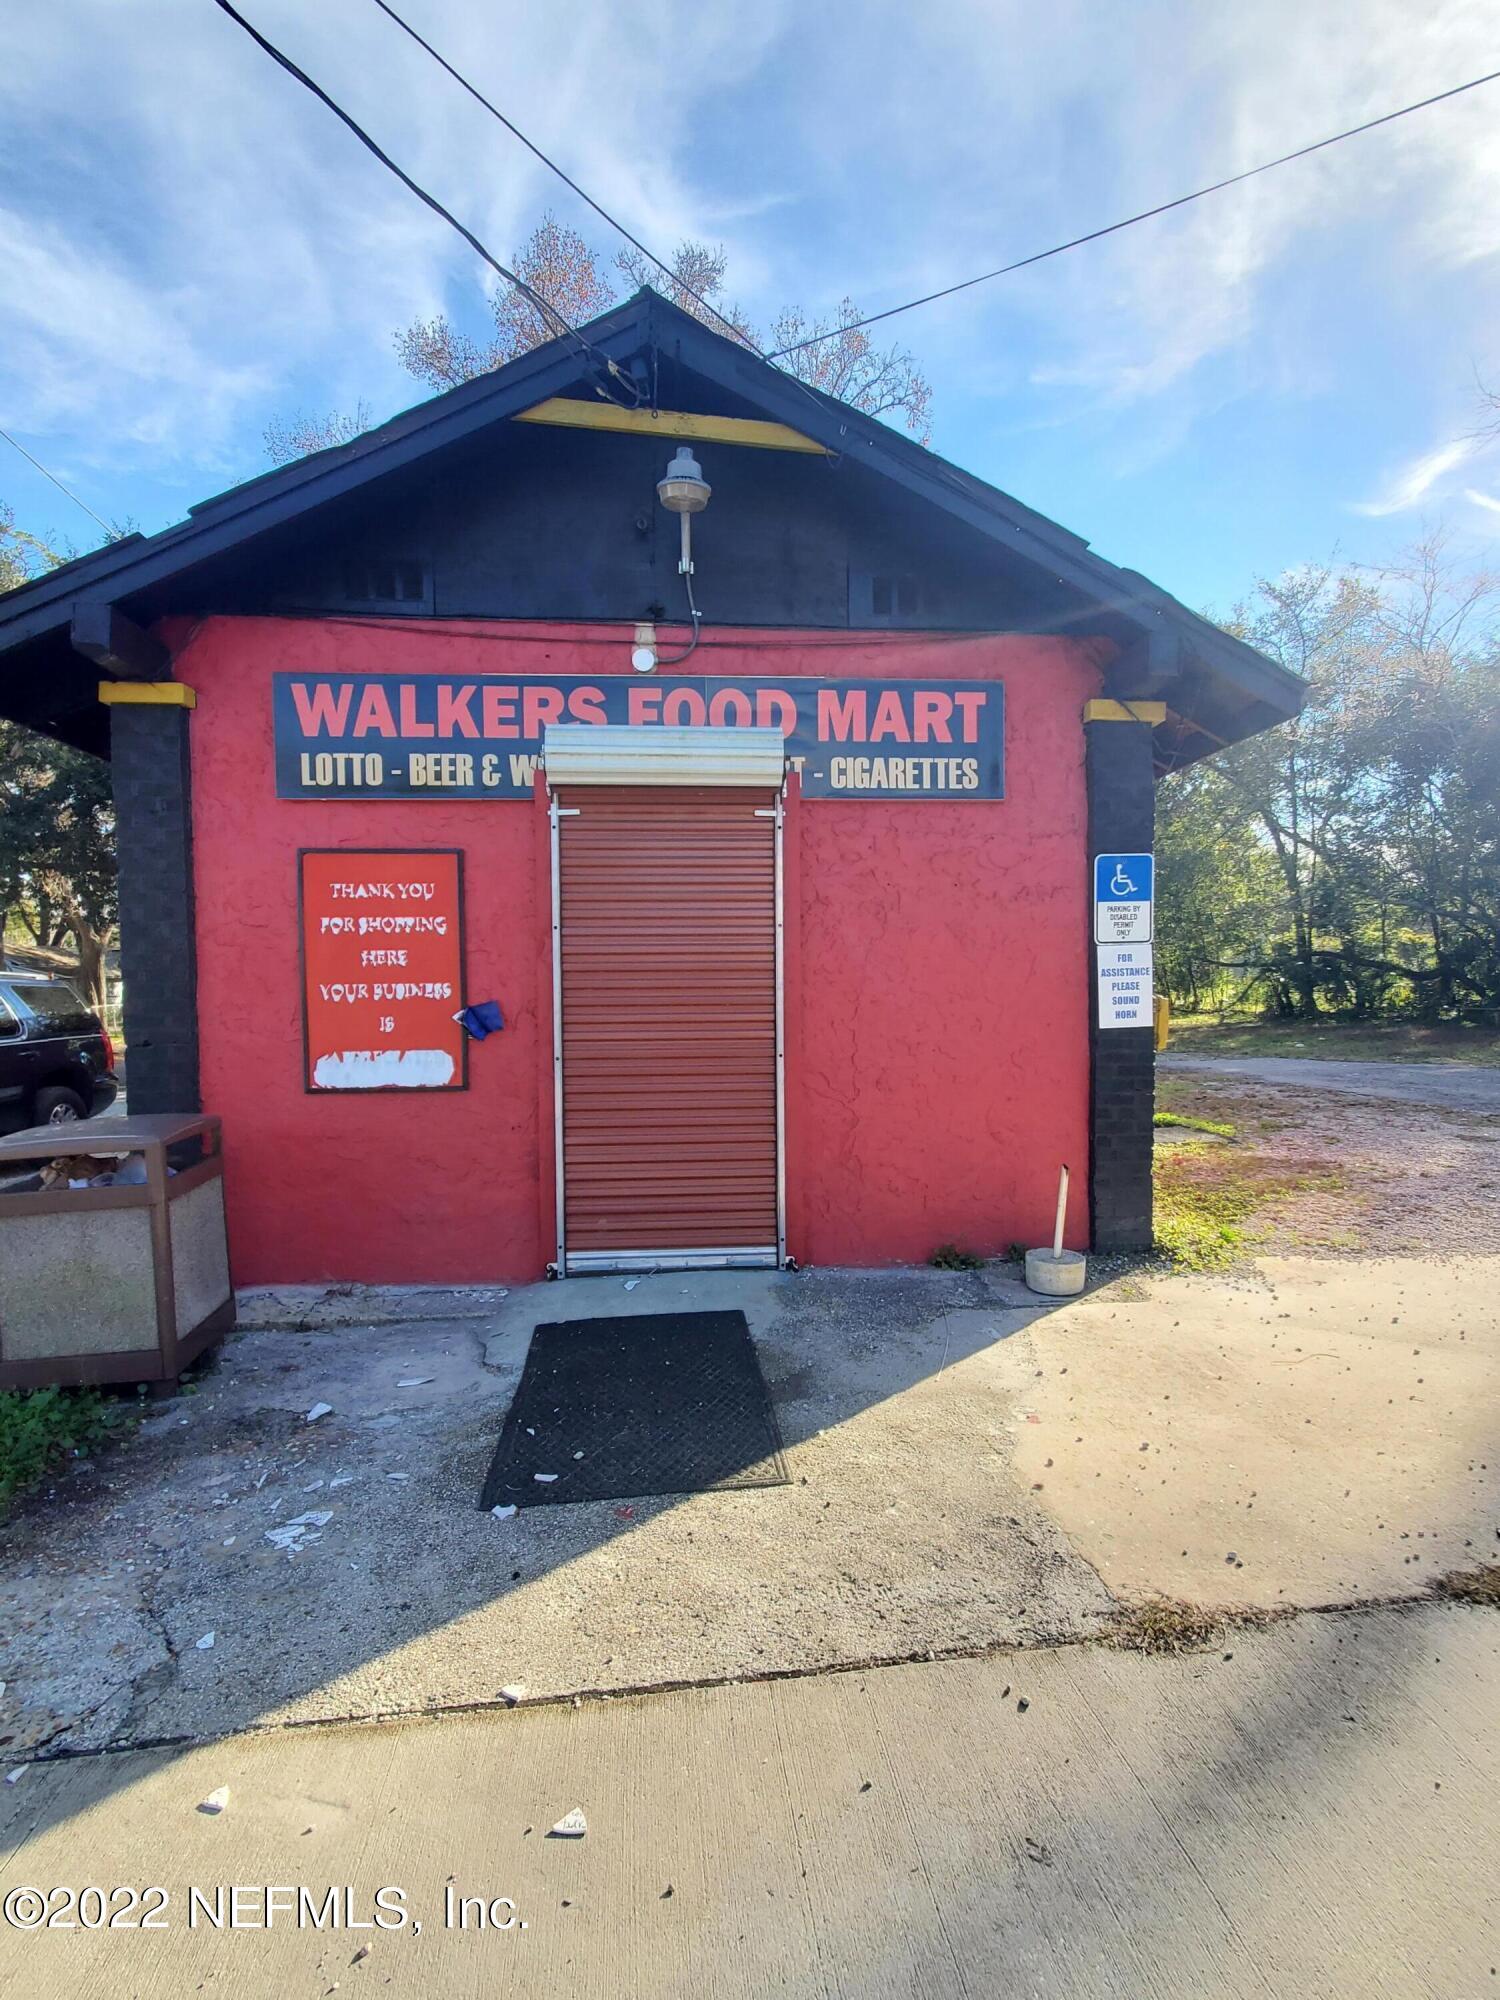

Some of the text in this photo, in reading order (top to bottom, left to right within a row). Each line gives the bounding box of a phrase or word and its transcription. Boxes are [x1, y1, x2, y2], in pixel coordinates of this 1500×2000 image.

[290, 683, 987, 743] WALKERS FOOD MART
[301, 753, 383, 786] LOTTO
[409, 753, 474, 787] BEER
[482, 754, 501, 787] &
[830, 757, 979, 789] CIGARETTES
[330, 883, 435, 901] THANK YOU
[1107, 905, 1131, 913] PARKING
[1109, 913, 1138, 921] DISABLED
[320, 916, 448, 935] FOR SHOPPING
[1113, 921, 1134, 929] PERMIT
[360, 950, 408, 967] HERE
[1117, 953, 1133, 963] FOR
[1101, 967, 1150, 977] ASSISTANCE
[1111, 981, 1140, 991] PLEASE
[319, 982, 452, 1003] YOUR BUSINESS
[1111, 996, 1140, 1005] SOUND
[1115, 1010, 1137, 1019] HORN
[379, 1016, 395, 1032] IS
